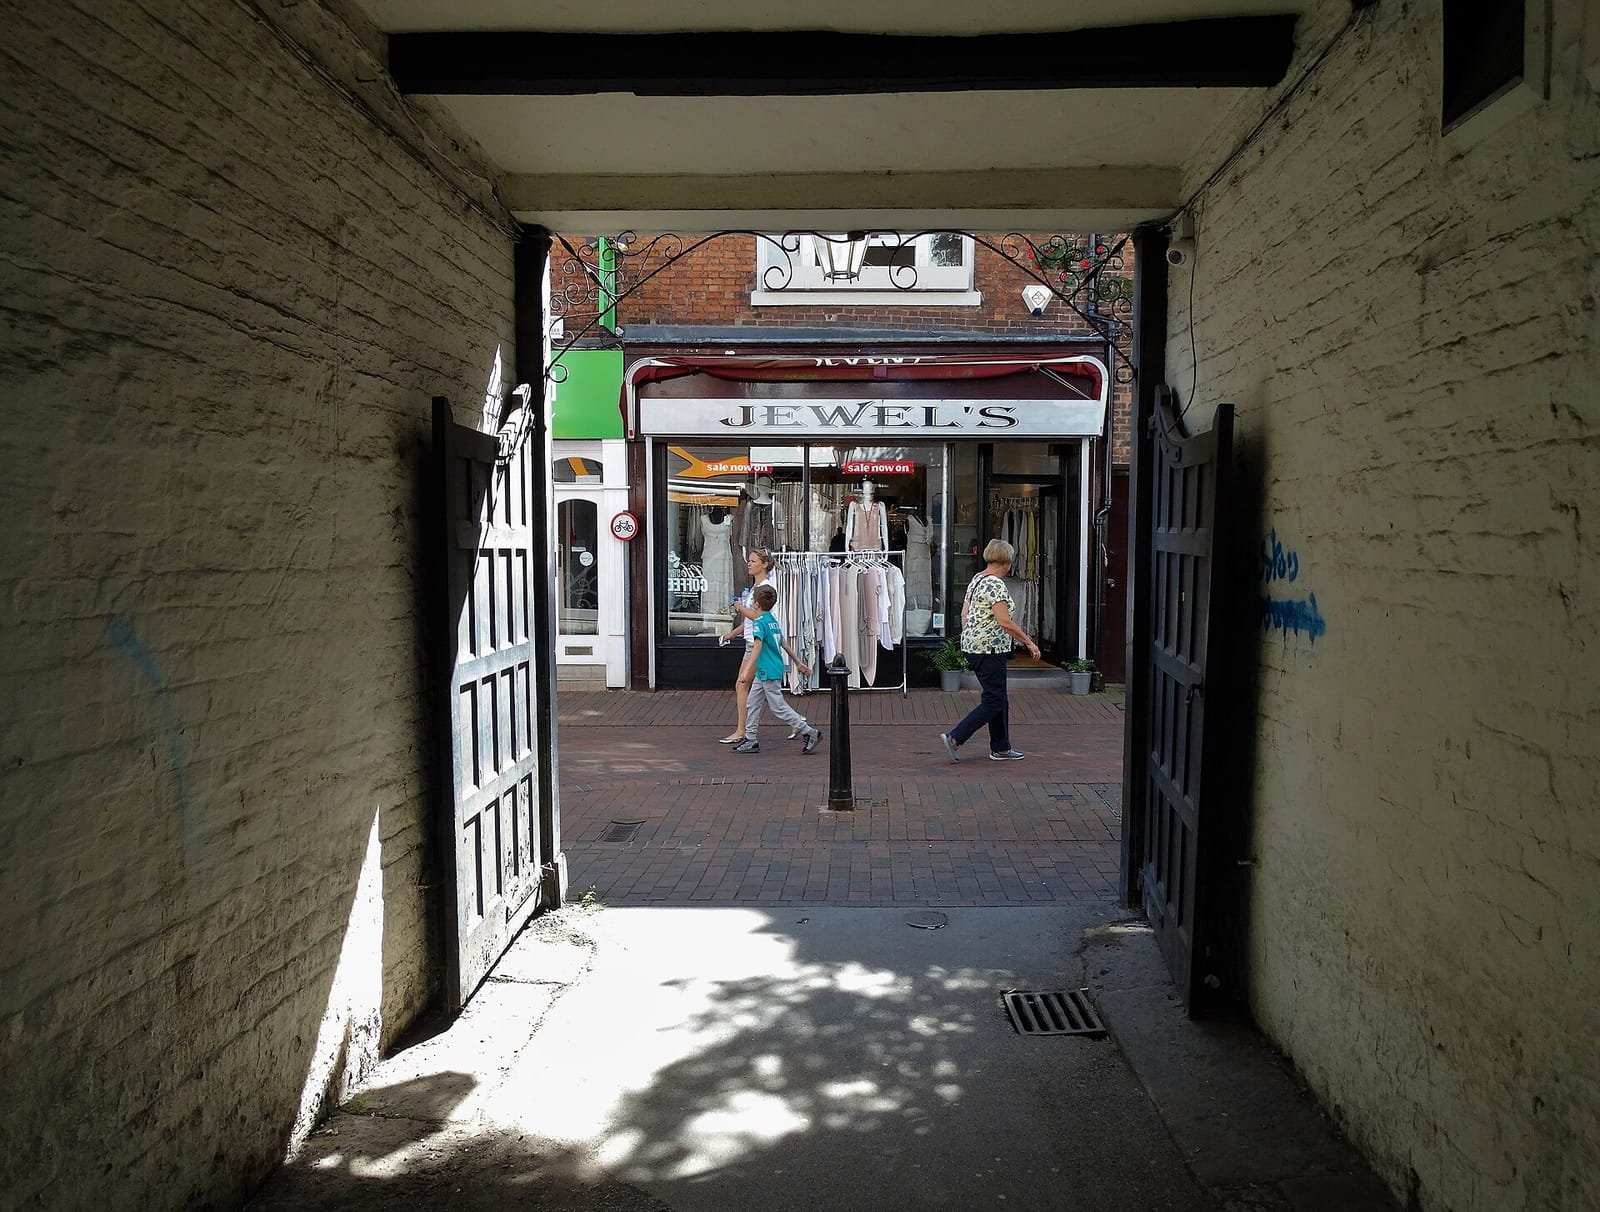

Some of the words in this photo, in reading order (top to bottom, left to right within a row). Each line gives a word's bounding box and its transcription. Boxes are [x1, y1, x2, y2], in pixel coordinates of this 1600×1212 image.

[719, 401, 1020, 429] JEWEL'S
[706, 464, 730, 472] sale
[753, 464, 768, 472] on
[848, 464, 870, 472] sale
